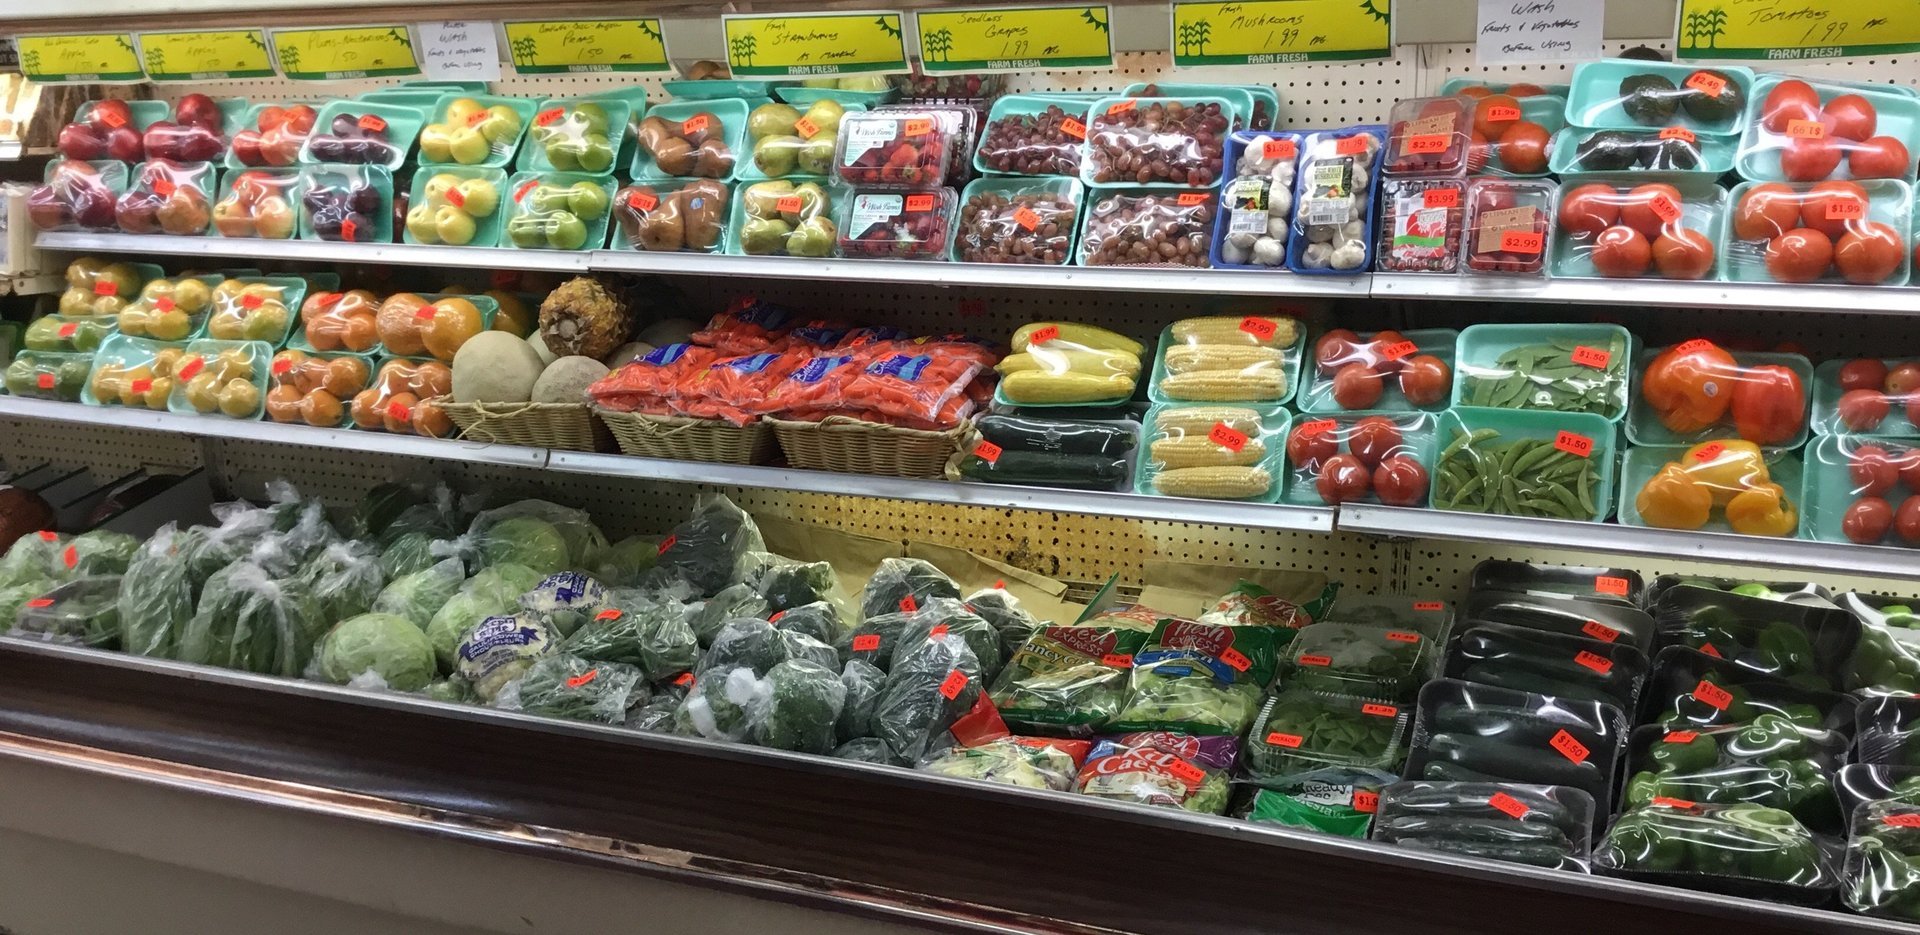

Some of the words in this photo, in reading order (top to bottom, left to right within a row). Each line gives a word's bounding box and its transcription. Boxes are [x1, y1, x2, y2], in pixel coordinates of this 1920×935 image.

[1247, 54, 1273, 64] FARM
[1276, 53, 1309, 63] FRESH
[1768, 49, 1801, 60] FARM
[1803, 47, 1843, 58] FRESH
[788, 66, 810, 75] FARM
[812, 65, 839, 74] FRESH
[987, 60, 1011, 69] FARM
[1012, 59, 1041, 68] FRESH
[1693, 75, 1719, 90] $2.49
[1491, 109, 1517, 117] $1.99
[687, 118, 705, 129] $1.50
[908, 122, 930, 131] $2.99
[1065, 120, 1086, 134] $1.99
[1792, 125, 1822, 136] $1.99
[1266, 144, 1290, 152] $1.99
[1412, 141, 1443, 149] $2.99
[780, 198, 798, 207] $1.50
[909, 199, 931, 207] $2.99
[1427, 195, 1454, 204] $3.99
[1654, 196, 1676, 217] $1.99
[1831, 204, 1861, 213] $1.99
[1506, 238, 1538, 247] $2.99
[1244, 320, 1270, 334] $2.99
[1035, 327, 1055, 340] $1.99
[1388, 343, 1411, 355] $1.99
[1578, 350, 1606, 362] $1.50
[1213, 429, 1240, 446] $2.99
[1559, 436, 1587, 450] $1.50
[1600, 579, 1624, 588] $1.50
[1589, 623, 1614, 638] $1.50
[1053, 630, 1104, 656] EXPRESS
[1168, 634, 1220, 653] EXPRESS
[1025, 642, 1062, 663] ancy
[1226, 652, 1248, 668] $3.49
[1582, 652, 1608, 666] $1.50
[1700, 683, 1727, 702] $1.50
[1558, 735, 1584, 757] $1.50
[1097, 756, 1175, 780] Caesa
[1358, 795, 1378, 806] $1.9
[1495, 795, 1522, 812] $1.50
